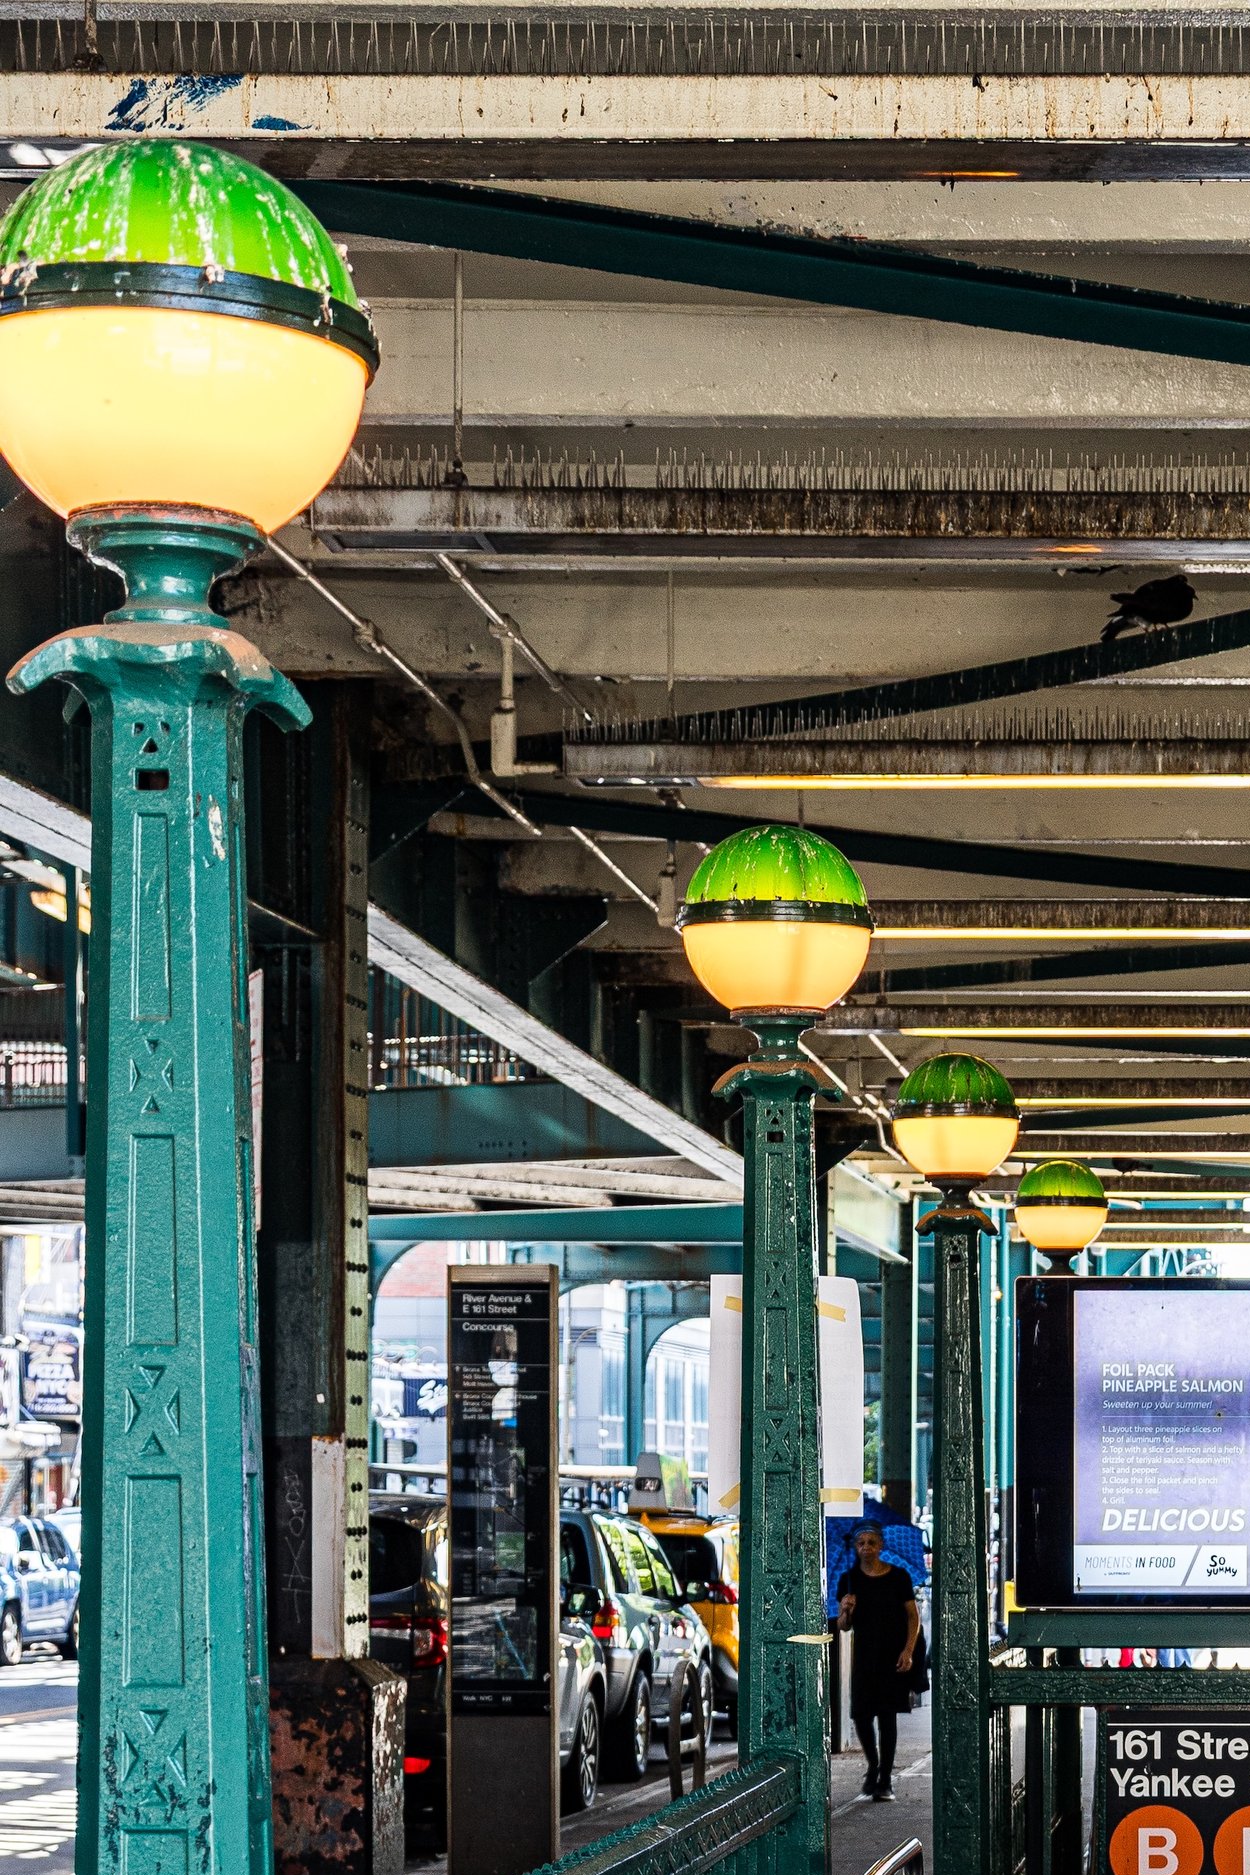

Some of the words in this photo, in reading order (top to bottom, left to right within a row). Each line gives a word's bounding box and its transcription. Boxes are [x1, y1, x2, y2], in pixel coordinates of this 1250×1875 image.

[462, 1293, 487, 1303] River
[488, 1293, 523, 1303] Avenue
[524, 1293, 532, 1303] &
[462, 1304, 470, 1314] E
[487, 1304, 518, 1314] Street
[461, 1321, 515, 1332] Concourse
[1102, 1363, 1134, 1377] FOIL
[1137, 1363, 1175, 1377] PACK
[1102, 1379, 1178, 1393] PINEAPPLE
[1181, 1379, 1244, 1393] SALMON
[1102, 1399, 1140, 1410] Sweeten
[1141, 1401, 1153, 1411] up
[1154, 1401, 1174, 1411] your
[1175, 1399, 1213, 1410] summer!
[1108, 1425, 1133, 1435] Layout
[1134, 1425, 1154, 1433] three
[1155, 1425, 1190, 1435] pineapple
[1192, 1425, 1211, 1433] slices
[1102, 1436, 1115, 1445] top
[1116, 1435, 1125, 1443] of
[1125, 1435, 1161, 1443] aluminum
[1110, 1446, 1123, 1455] Top
[1124, 1445, 1141, 1453] with
[1148, 1445, 1164, 1453] slice
[1165, 1445, 1174, 1453] of
[1175, 1445, 1201, 1453] salmon
[1202, 1445, 1217, 1453] and
[1224, 1445, 1244, 1455] hefty
[1102, 1456, 1125, 1464] drizzle
[1126, 1456, 1135, 1464] of
[1136, 1456, 1162, 1466] teriyaki
[1187, 1456, 1213, 1464] Season
[1213, 1456, 1231, 1464] with
[1102, 1466, 1115, 1474] salt
[1116, 1466, 1130, 1474] and
[1131, 1468, 1159, 1476] pepper.
[1109, 1476, 1129, 1484] Close
[1130, 1476, 1143, 1484] the
[1144, 1476, 1156, 1484] foil
[1157, 1476, 1181, 1486] packet
[1182, 1476, 1197, 1484] and
[1198, 1476, 1218, 1486] pinch
[1102, 1486, 1114, 1494] the
[1115, 1486, 1134, 1494] sides
[1102, 1508, 1247, 1533] DELICIOUS
[1084, 1556, 1133, 1569] MOMENTS
[1135, 1556, 1147, 1569] IN
[1148, 1556, 1176, 1569] FOOD
[1109, 1730, 1162, 1760] 161
[1109, 1767, 1236, 1798] Yankee
